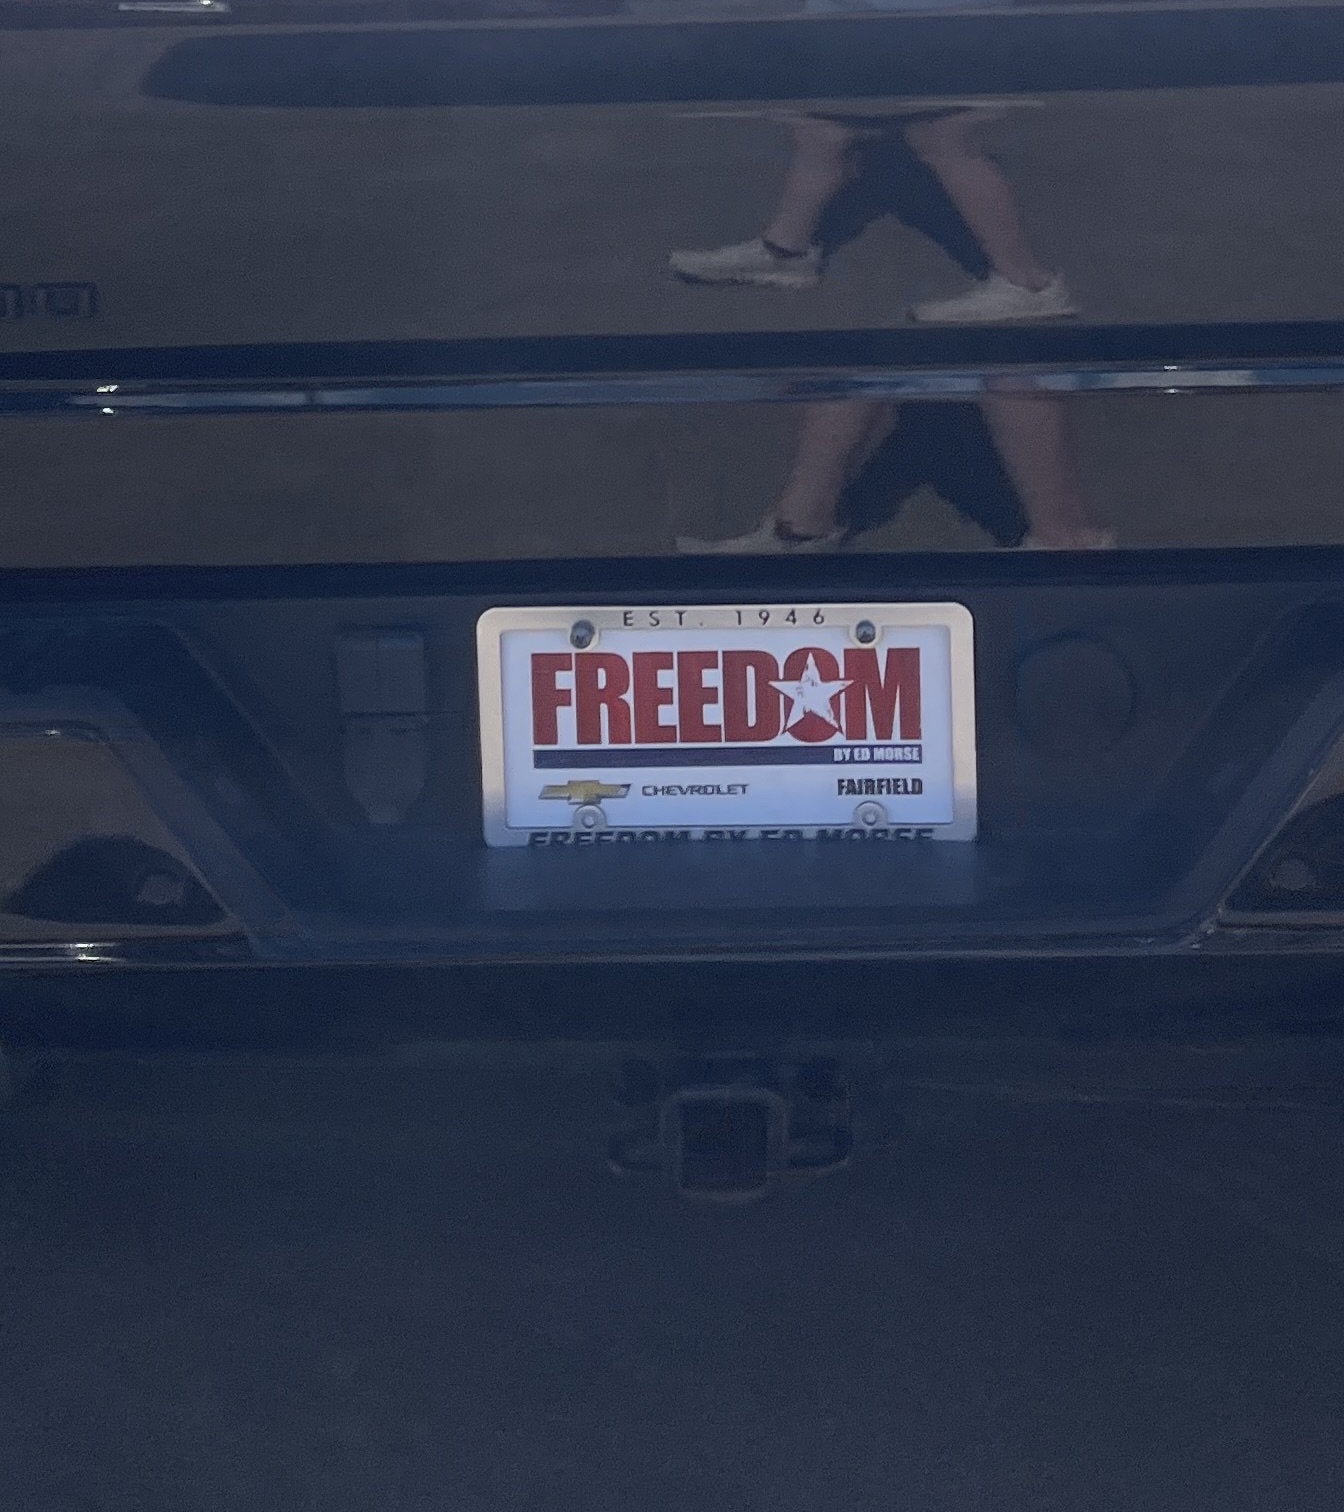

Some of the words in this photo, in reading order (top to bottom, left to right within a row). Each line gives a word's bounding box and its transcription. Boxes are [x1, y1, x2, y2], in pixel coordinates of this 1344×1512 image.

[623, 610, 704, 628] EST.
[736, 609, 825, 626] 1946
[531, 647, 922, 745] FREEDOM
[833, 748, 851, 762] BY
[853, 748, 871, 761] ED
[873, 747, 920, 761] MORSE
[641, 784, 749, 797] CHEVROLET
[837, 778, 923, 795] FAIRFIELD
